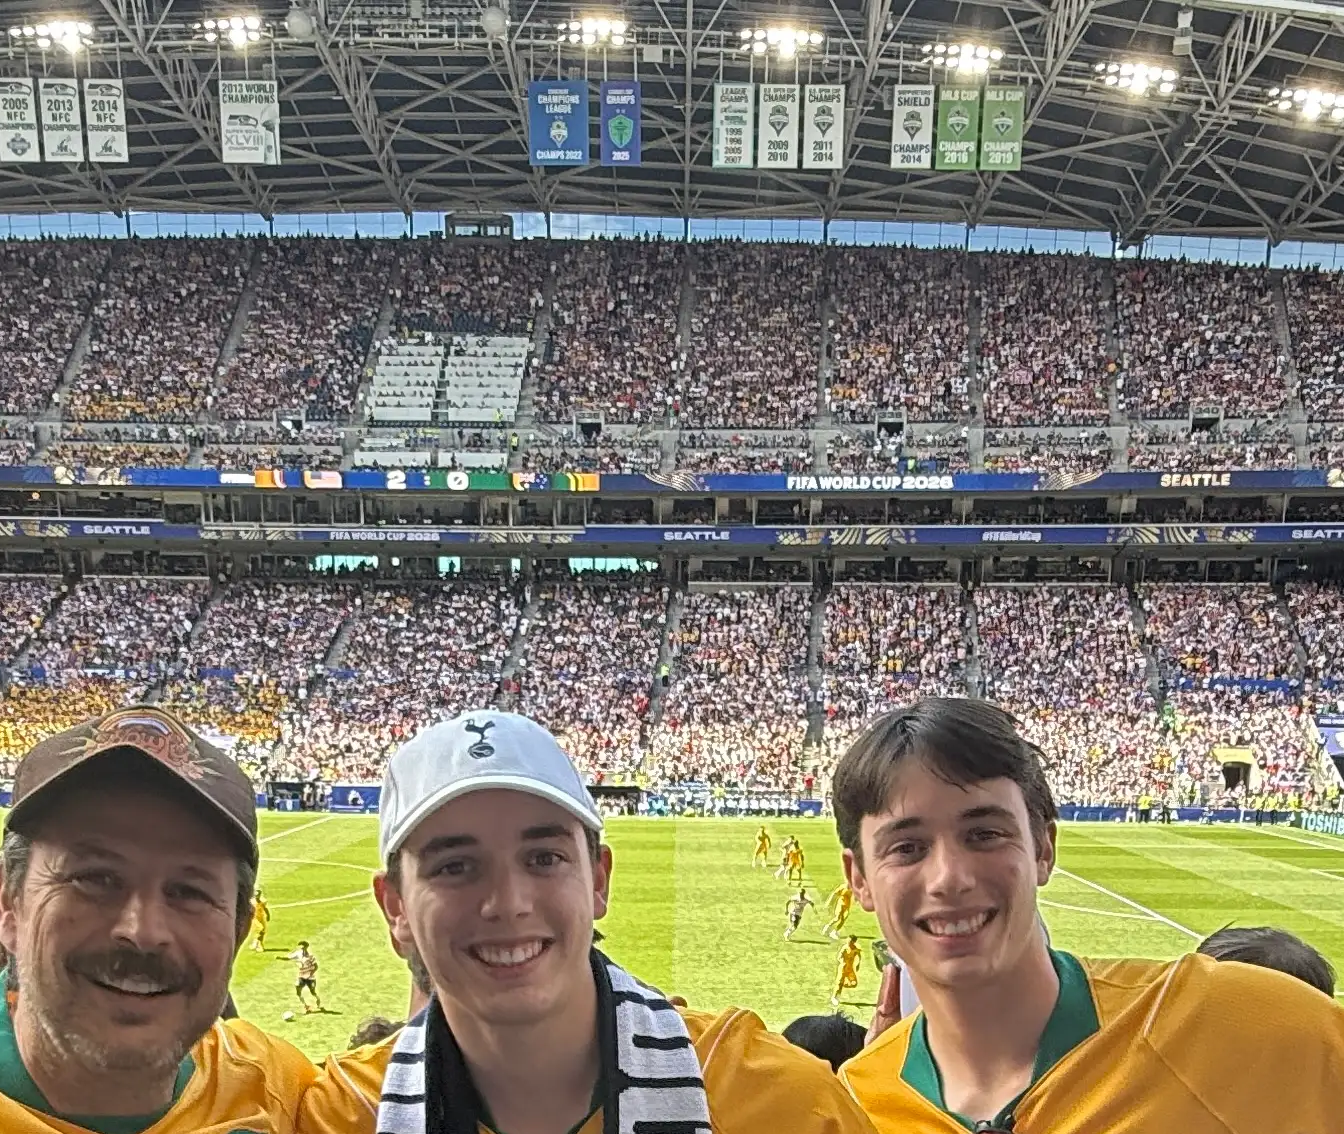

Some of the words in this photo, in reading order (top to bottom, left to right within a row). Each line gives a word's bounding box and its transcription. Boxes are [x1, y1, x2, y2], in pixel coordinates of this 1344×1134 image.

[222, 83, 243, 93] 2013
[245, 83, 275, 93] WORLD
[222, 94, 275, 104] CHAMPIONS
[763, 94, 796, 103] CHAMPS
[808, 94, 841, 103] CHAMPS
[941, 90, 959, 101] MLS
[960, 90, 978, 101] CUP
[986, 91, 1004, 101] MLS
[1005, 91, 1024, 101] CUP
[2, 98, 28, 110] 2005
[47, 100, 73, 111] 2013
[91, 100, 118, 112] 2014
[897, 97, 931, 107] SHIELD
[545, 104, 572, 114] LEAGUE
[7, 112, 26, 121] NFC
[51, 113, 71, 123] NFC
[96, 113, 116, 123] NFC
[768, 140, 789, 150] 2009
[813, 141, 833, 150] 2011
[893, 144, 930, 153] CHAMPS
[939, 141, 975, 151] CHAMPS
[983, 141, 1020, 152] CHAMPS
[768, 152, 789, 162] 2010
[813, 152, 834, 162] 2014
[900, 155, 922, 163] 2014
[1196, 407, 1219, 415] 340
[386, 470, 407, 490] 2
[447, 470, 469, 491] 0
[787, 475, 817, 490] FIFA
[819, 475, 870, 490] WORLD
[872, 476, 901, 490] CUP
[1160, 473, 1231, 487] SEATTLE
[83, 524, 151, 535] SEATTLE
[330, 531, 351, 541] FIFA
[353, 532, 385, 541] WORLD
[387, 532, 405, 541] CUP
[664, 531, 730, 541] SEATTLE
